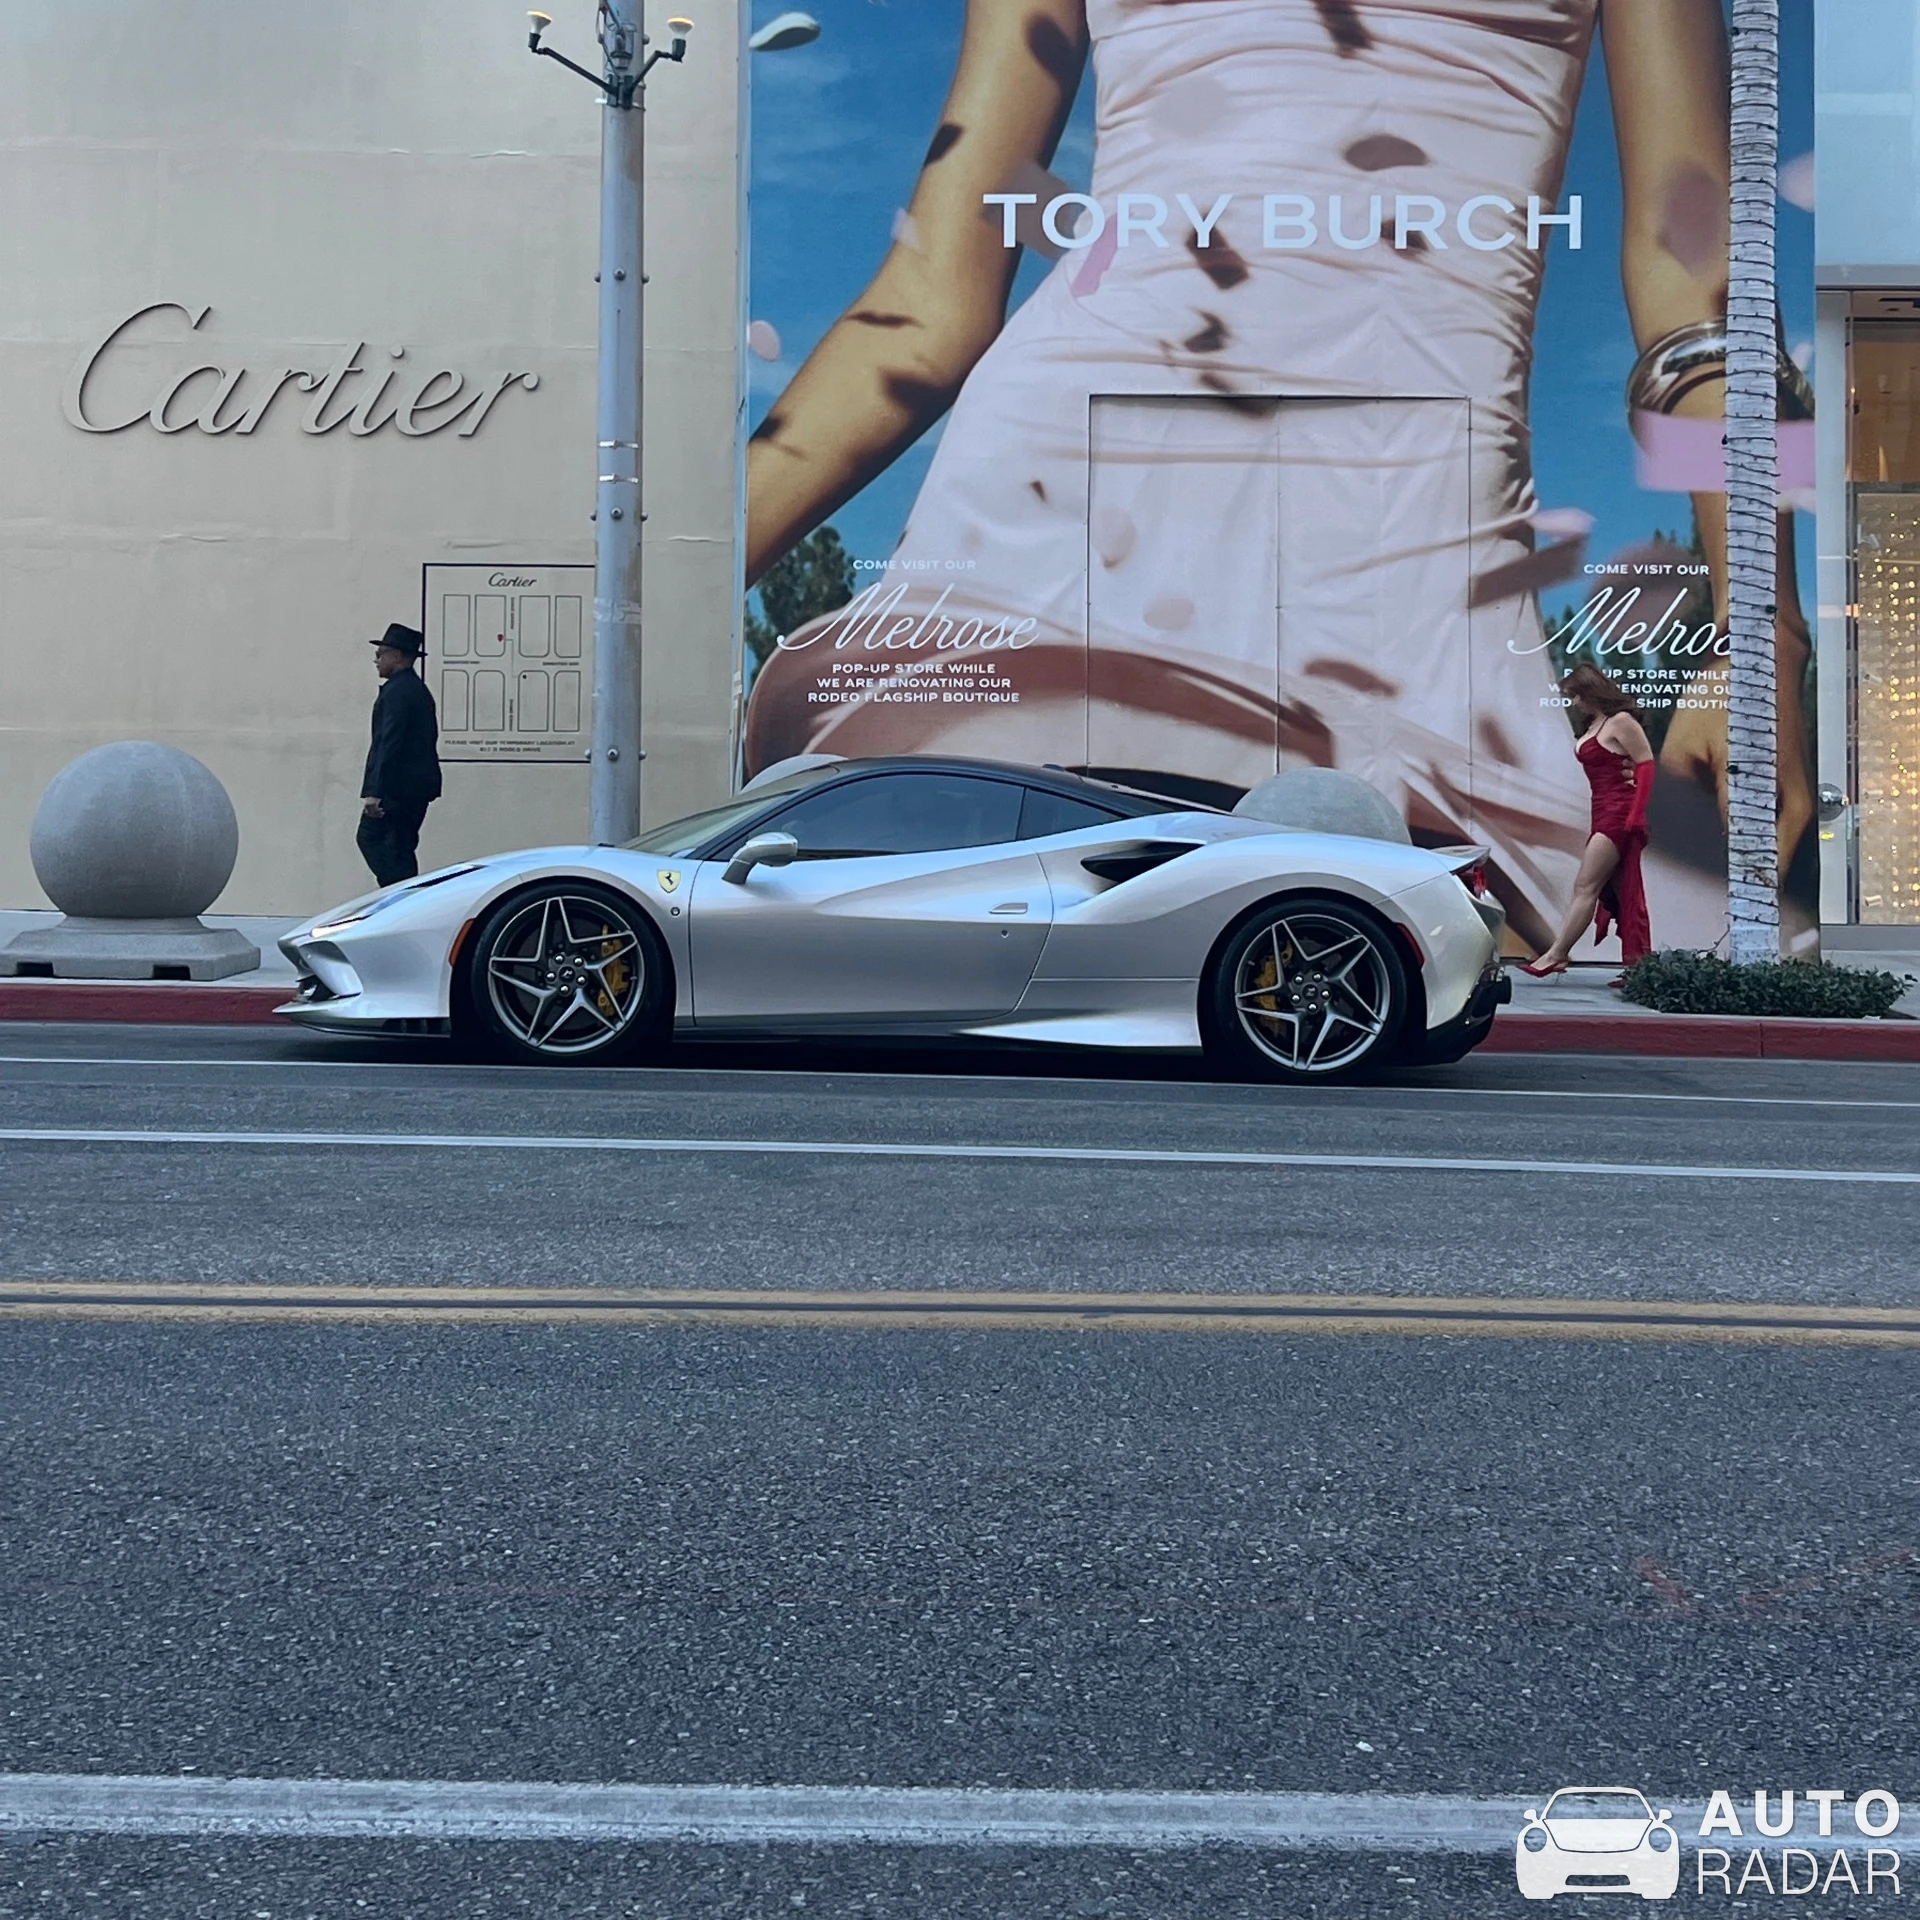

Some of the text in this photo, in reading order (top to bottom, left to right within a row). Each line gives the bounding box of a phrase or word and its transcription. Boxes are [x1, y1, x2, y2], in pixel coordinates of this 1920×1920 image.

[983, 193, 1583, 251] TORY BURCH
[63, 302, 541, 439] Cartier
[853, 559, 976, 571] COME VISIT OUR
[1584, 563, 1710, 576] COME VISIT OUR
[488, 572, 538, 588] Cartier
[776, 581, 1041, 651] Melrose
[832, 663, 996, 675] POP-UP STORE WHILE
[1626, 668, 1677, 680] STORE
[816, 677, 1012, 688] WE ARE RENOVATING OUR
[1615, 683, 1709, 695] ENOVATING
[807, 692, 1020, 703] RODEO FLAGSHIP BOUTIQUE
[1539, 697, 1573, 708] ROD
